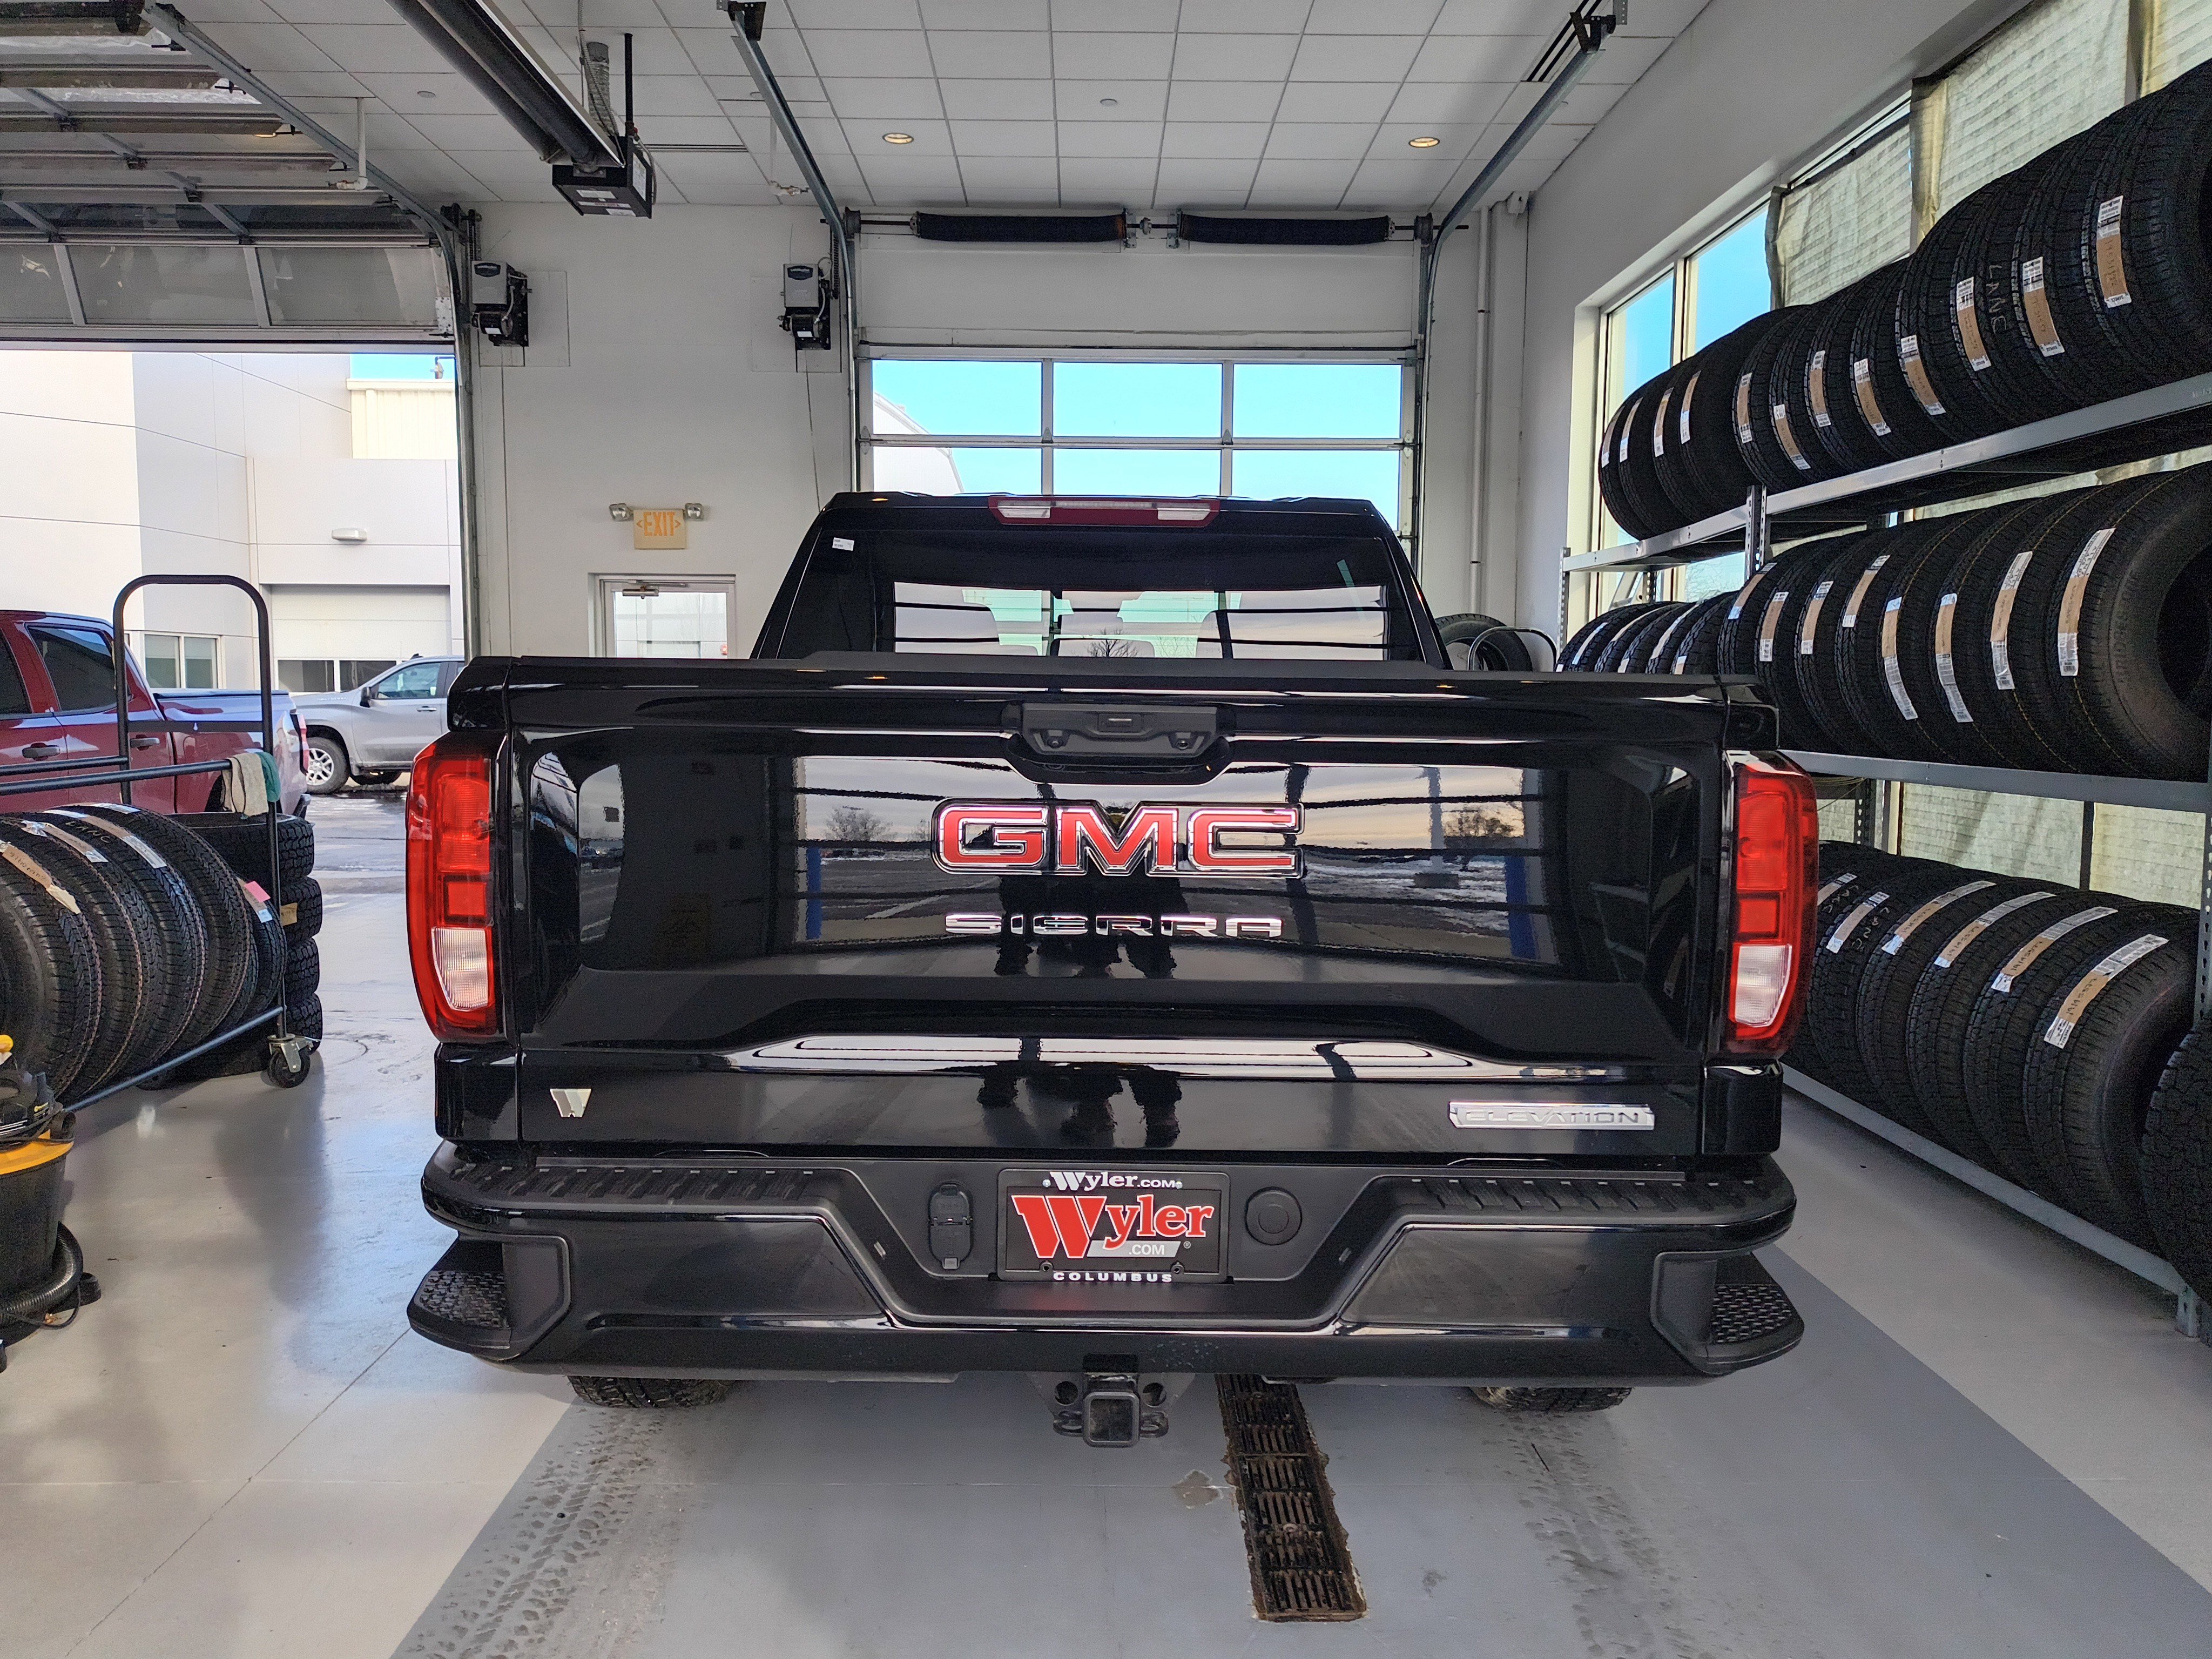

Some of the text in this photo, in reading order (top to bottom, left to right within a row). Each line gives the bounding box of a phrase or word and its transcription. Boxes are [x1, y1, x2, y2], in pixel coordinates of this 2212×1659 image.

[643, 511, 676, 536] EXIT
[933, 799, 1304, 878] GMC
[945, 913, 1283, 938] SIERRA
[1465, 1110, 1639, 1124] ELEVATION
[1011, 1193, 1215, 1258] Wyler
[1128, 1244, 1165, 1256] .COM
[1053, 1271, 1172, 1283] COLUMBUS
